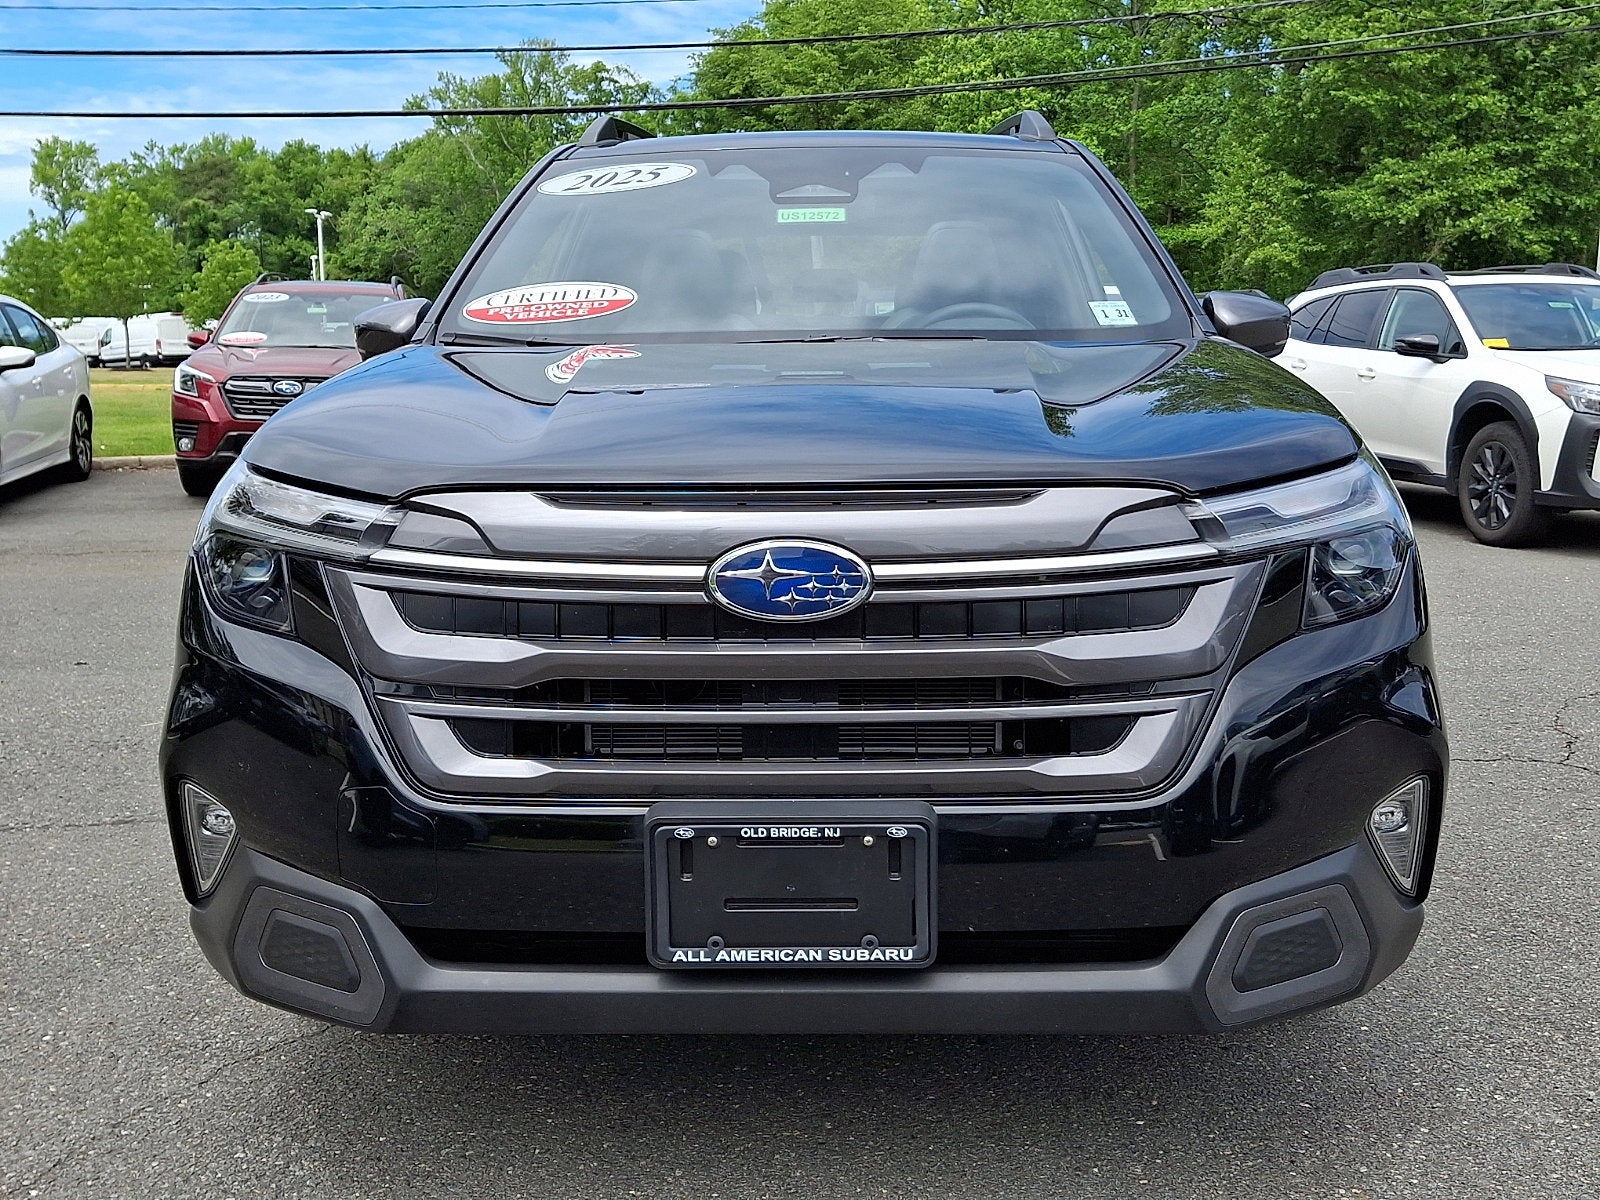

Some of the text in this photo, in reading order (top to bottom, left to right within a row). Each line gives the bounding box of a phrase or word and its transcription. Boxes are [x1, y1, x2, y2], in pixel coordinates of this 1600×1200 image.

[562, 166, 669, 192] 2025
[781, 211, 840, 221] US12572
[486, 288, 618, 306] CERTIFIED
[487, 300, 609, 316] PRE-OWNED
[504, 308, 589, 320] VEHICLE
[740, 827, 767, 838] OLD
[824, 827, 840, 838] NJ
[672, 948, 913, 962] ALL AMERICAN SUBARU
